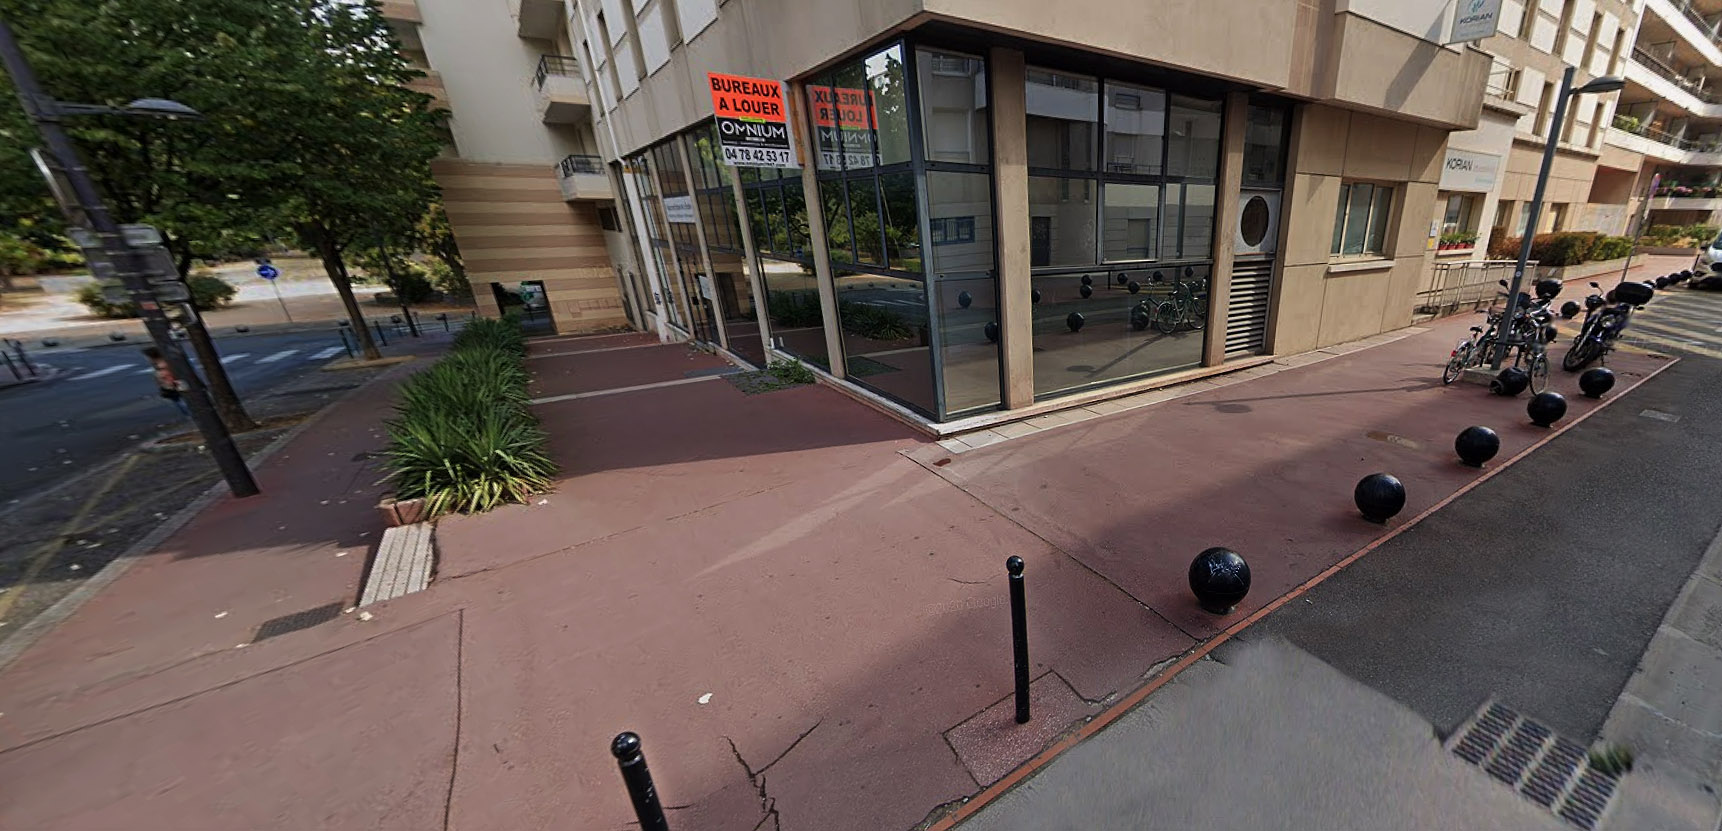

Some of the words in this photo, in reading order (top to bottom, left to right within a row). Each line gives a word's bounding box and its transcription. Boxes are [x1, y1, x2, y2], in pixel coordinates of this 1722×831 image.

[1460, 12, 1493, 24] KORIAN
[711, 77, 780, 99] BUREAUX
[720, 97, 729, 111] A
[733, 98, 780, 116] LOUER
[721, 121, 786, 139] OMNIUM
[725, 147, 737, 159] 04
[739, 148, 751, 160] 78
[753, 149, 764, 161] 42
[766, 150, 778, 162] 53
[779, 151, 790, 163] 17
[1446, 158, 1474, 171] KORIAN
